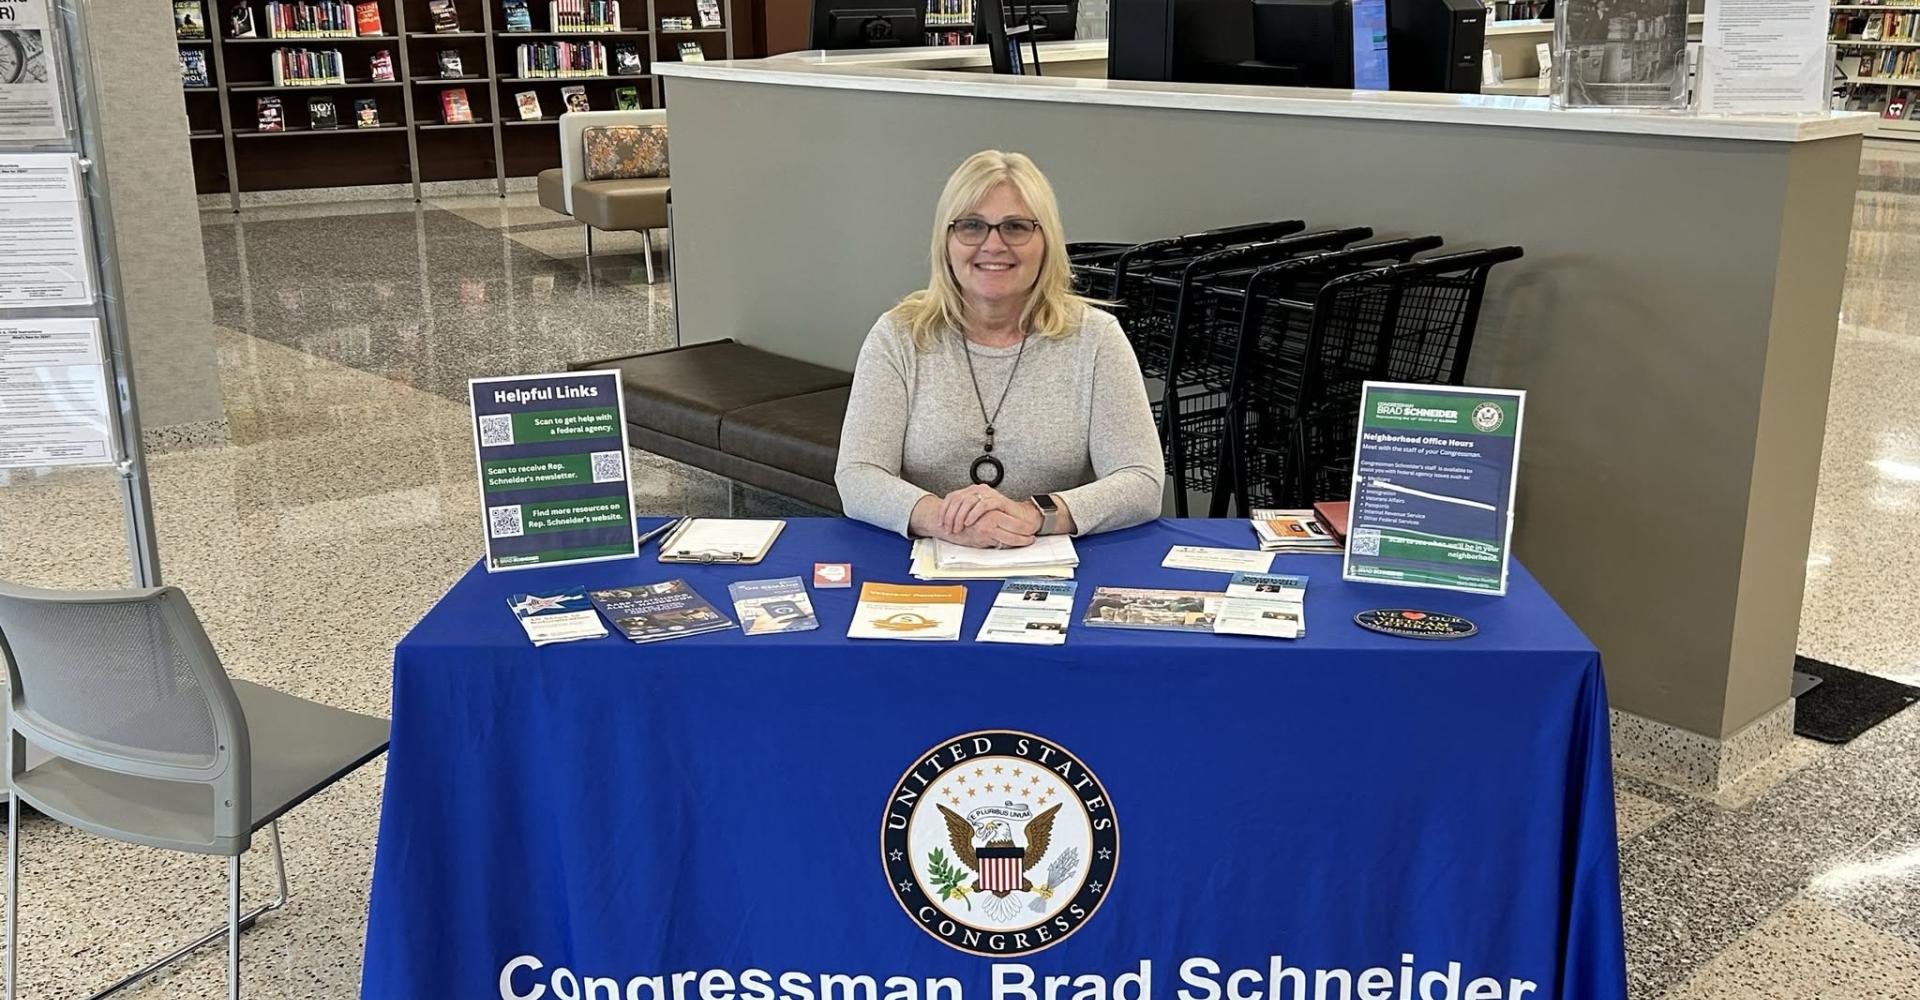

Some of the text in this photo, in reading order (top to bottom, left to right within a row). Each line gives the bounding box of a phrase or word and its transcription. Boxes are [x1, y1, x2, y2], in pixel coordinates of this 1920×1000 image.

[494, 385, 598, 404] Helpful Links
[1376, 406, 1458, 419] BRAD SCHNEIDER
[534, 413, 612, 426] Scan to get help with
[557, 426, 583, 434] federal
[584, 424, 614, 434] agency.
[1363, 432, 1474, 448] Neighborhood Office Hours
[1439, 448, 1482, 458] Congressman.
[488, 462, 565, 475] Scan to receive Rep.
[489, 471, 578, 485] Schneider's newsletter.
[532, 509, 550, 517] Find
[550, 507, 571, 516] more
[572, 504, 609, 514] resources
[528, 513, 623, 528] Rep. Schneider's website.
[1373, 620, 1455, 632] VETERANS
[1379, 616, 1450, 628] VIETNAM
[889, 737, 1112, 831] UNITED STATES
[976, 808, 1009, 817] PLURIBUS
[1010, 811, 1030, 819] UNUM
[919, 903, 1086, 951] CONGRESS
[500, 954, 1537, 1000] Congressman Brad Schneider
